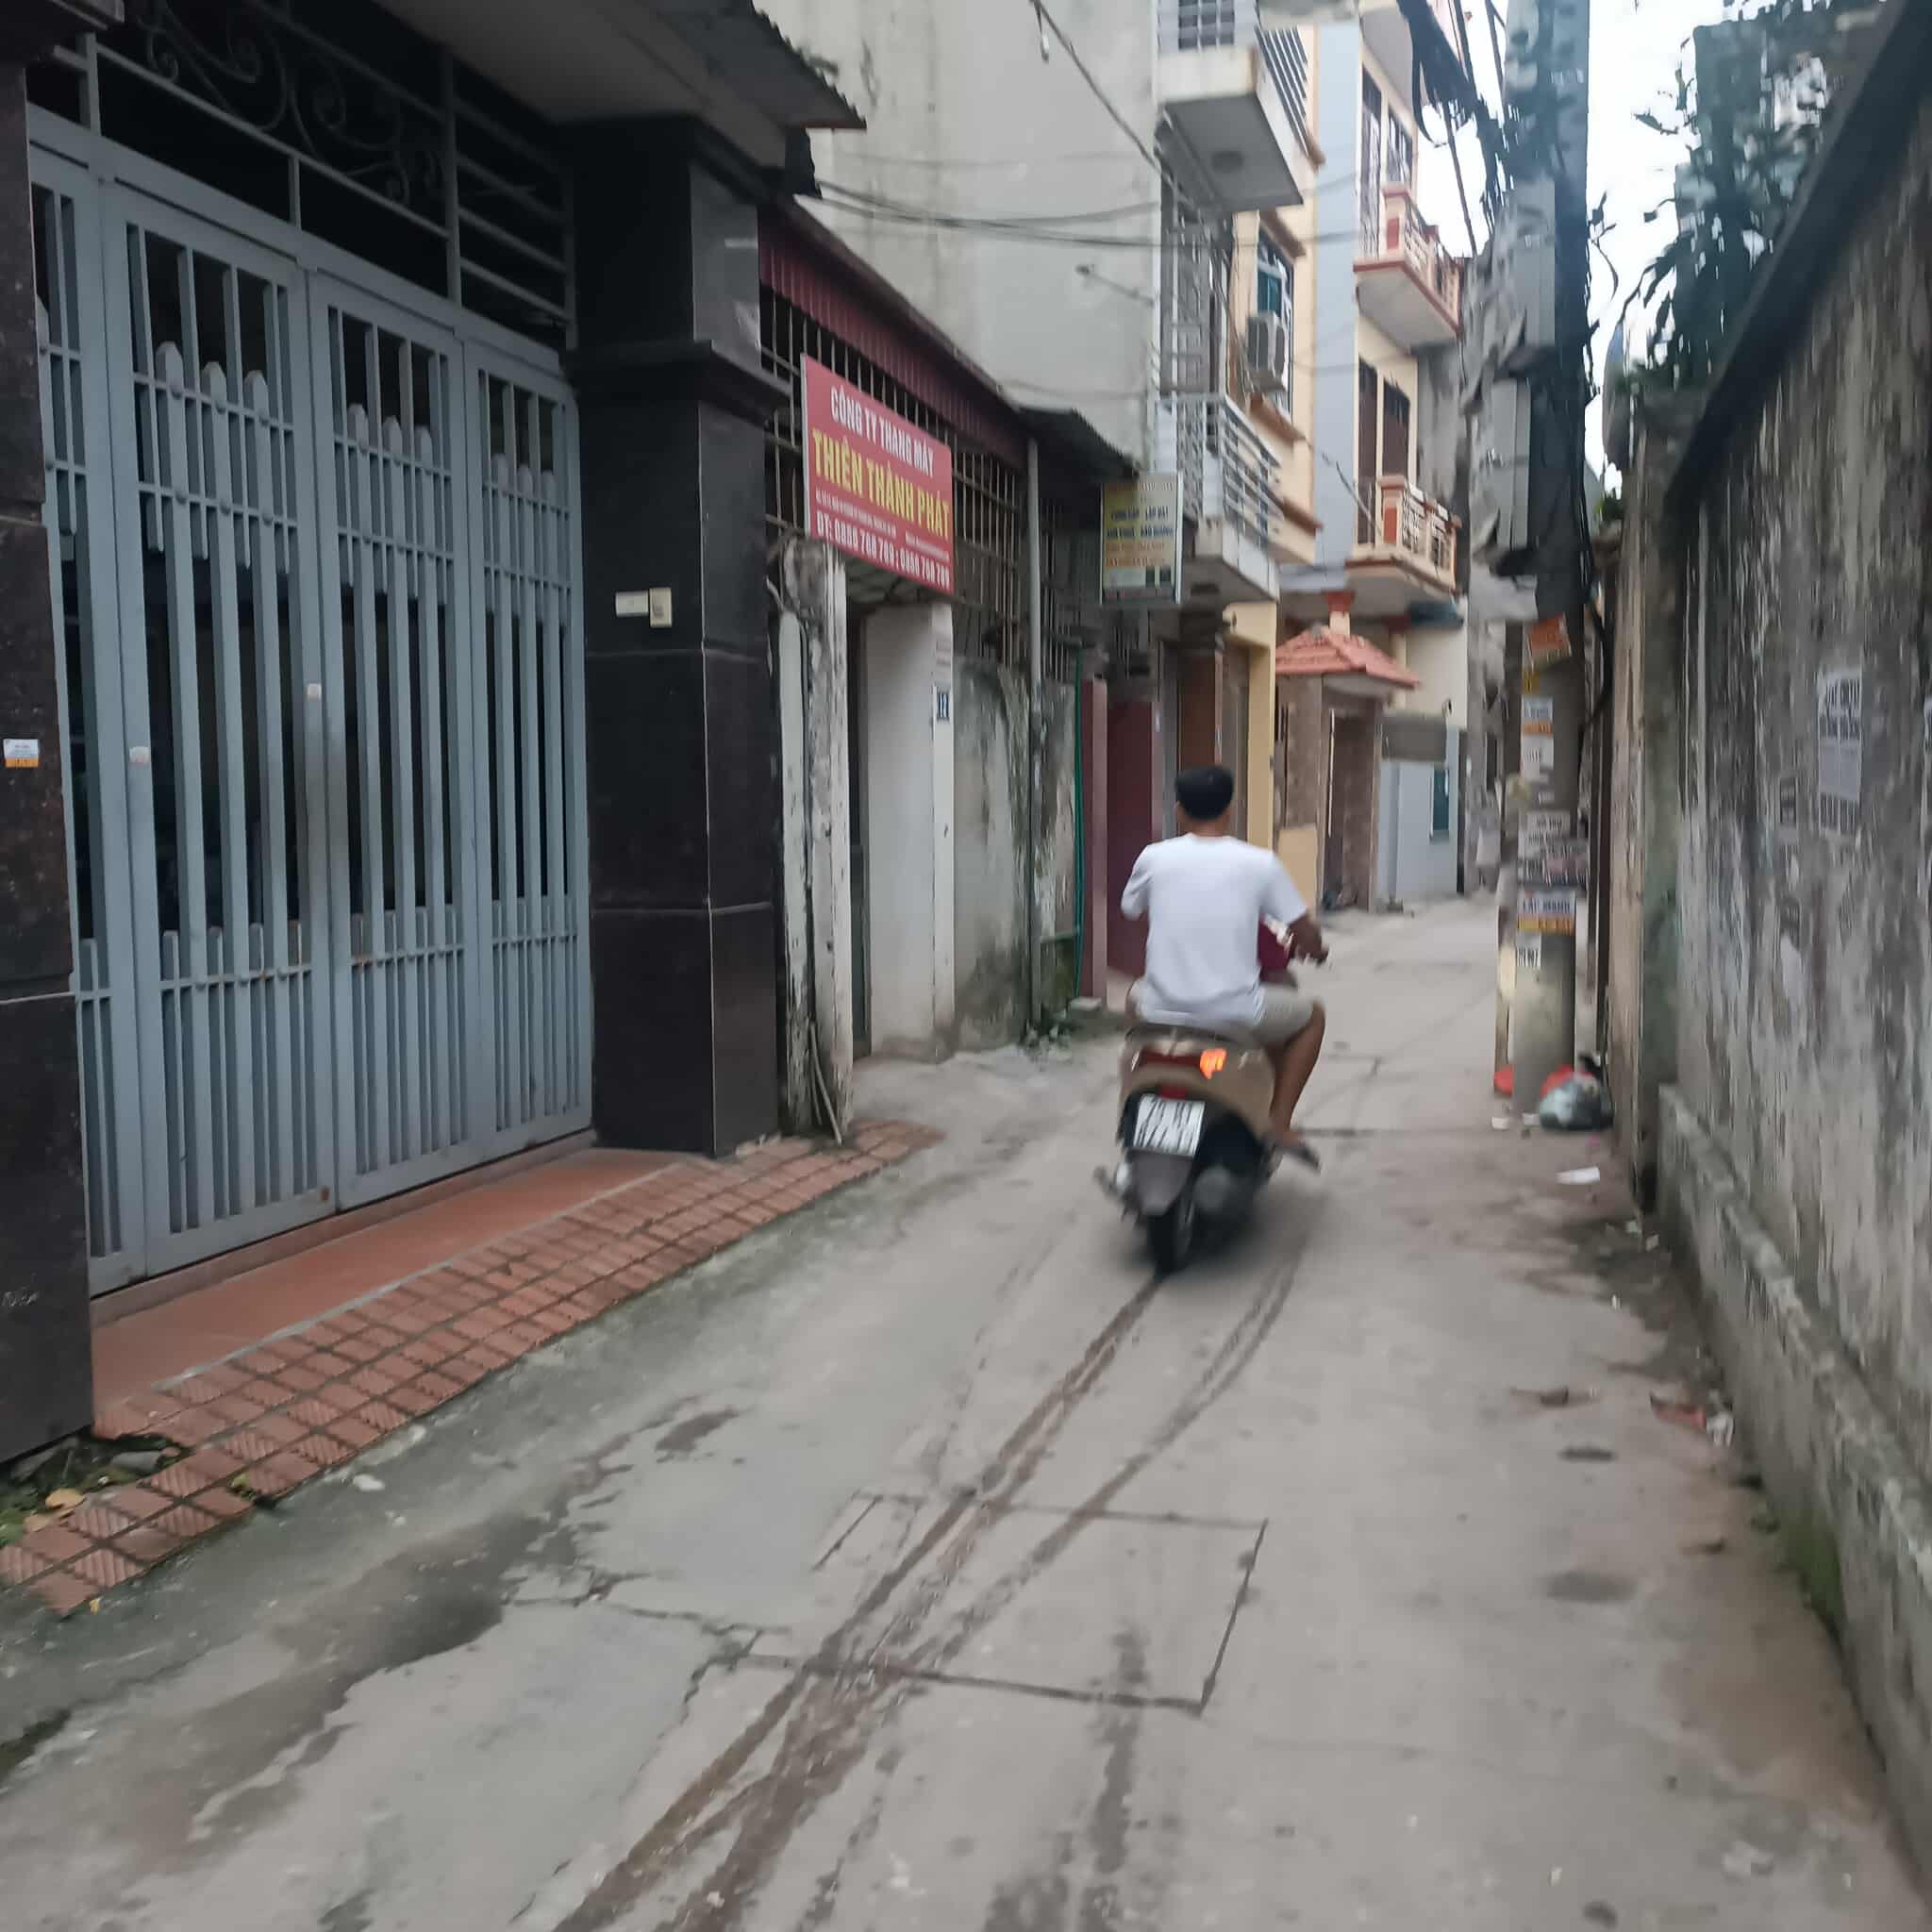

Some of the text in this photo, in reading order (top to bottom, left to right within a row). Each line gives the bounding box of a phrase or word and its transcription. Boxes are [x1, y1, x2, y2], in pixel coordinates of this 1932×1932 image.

[812, 426, 862, 497] THIÊN
[916, 487, 949, 541] PHÁT
[830, 385, 934, 479] CÔNG TY THANG MÁY
